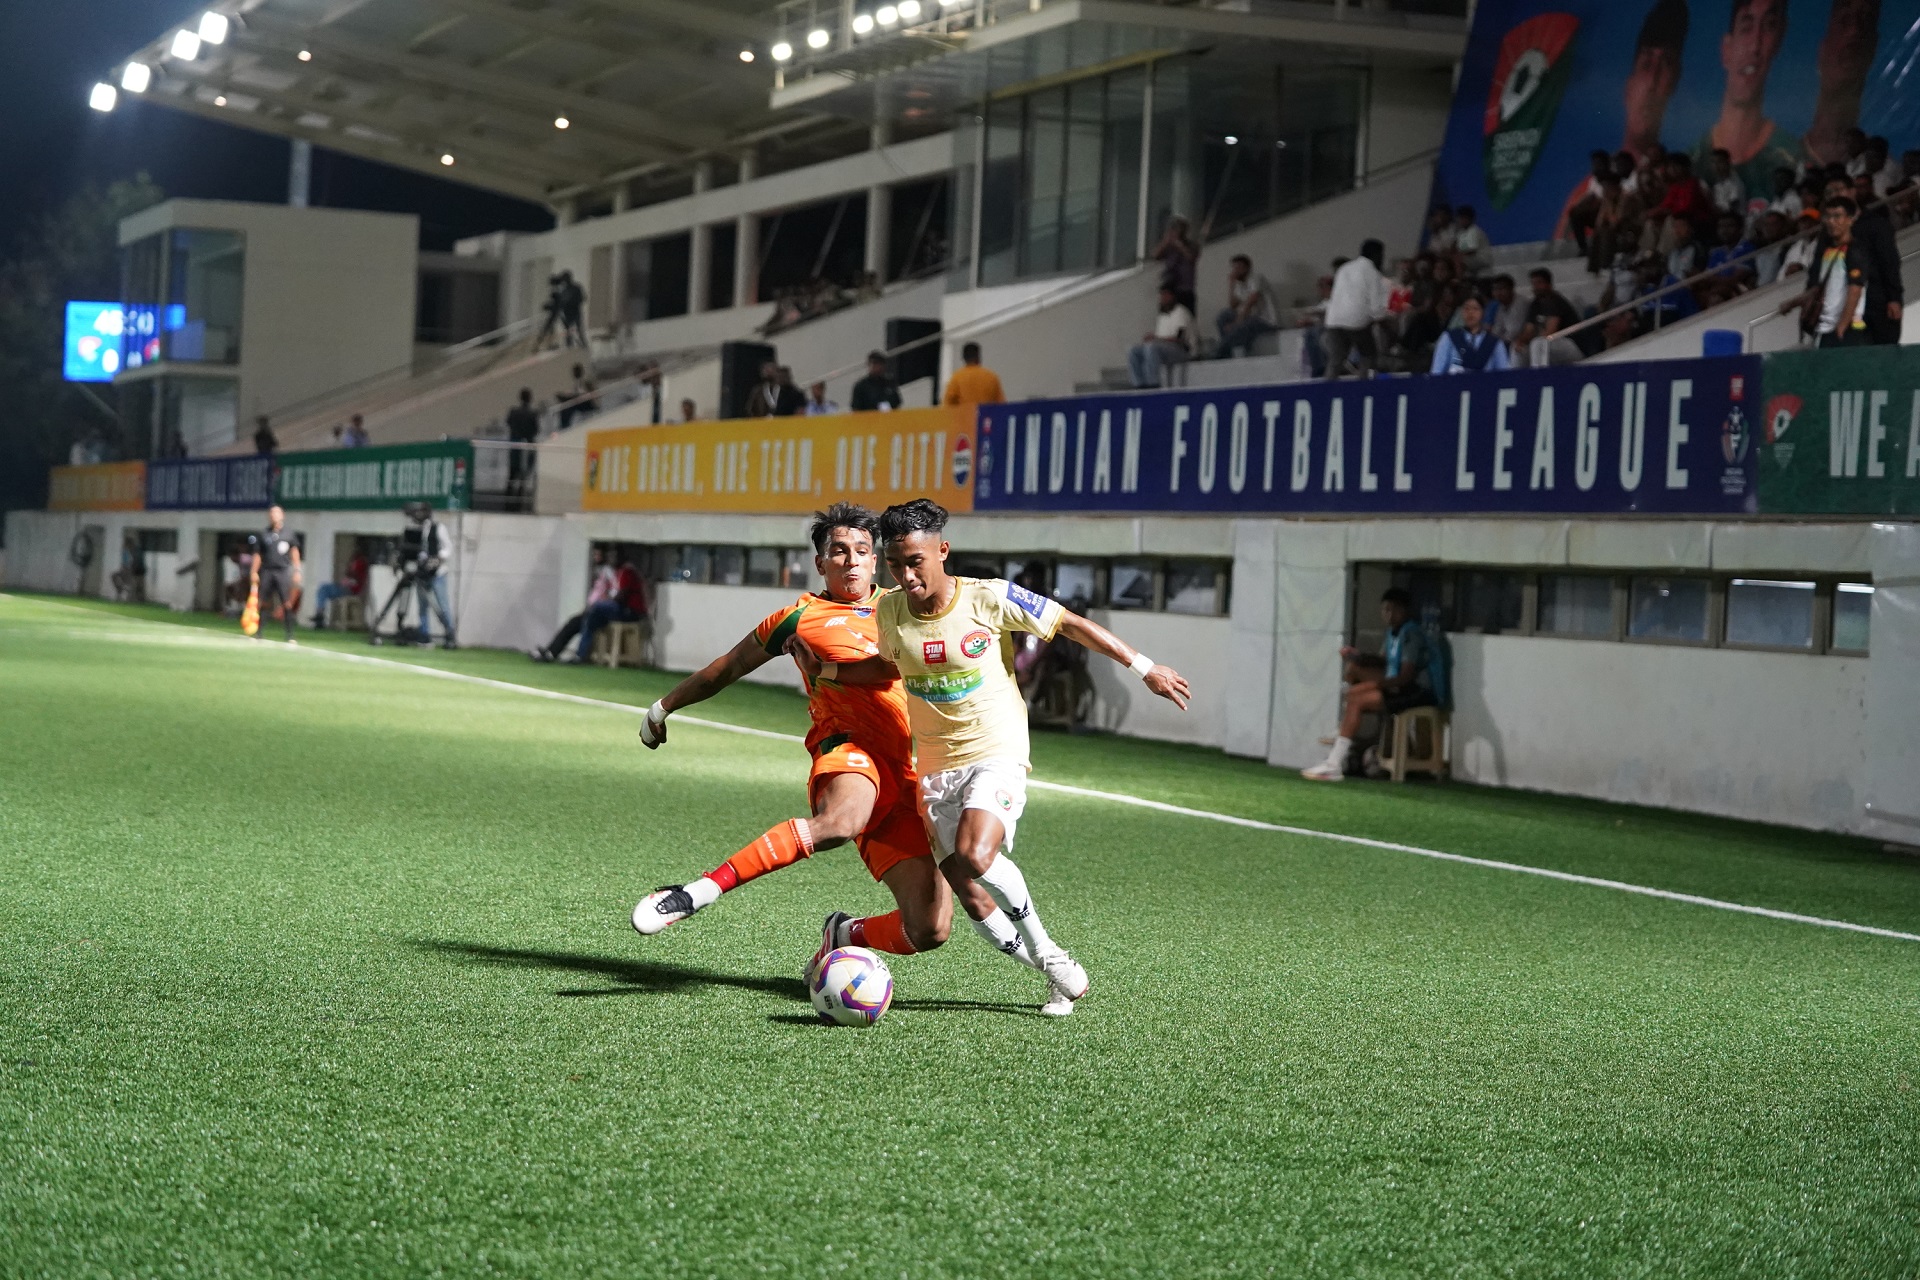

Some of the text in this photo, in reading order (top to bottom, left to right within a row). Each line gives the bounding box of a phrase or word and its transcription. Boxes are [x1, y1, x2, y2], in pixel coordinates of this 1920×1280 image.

[1004, 378, 1694, 495] INDIAN FOOTBALL LEAGUE
[1829, 390, 1889, 478] WE
[600, 444, 632, 493] ONE
[714, 441, 750, 493] ONE
[835, 433, 877, 492] ONE
[889, 430, 948, 492] CITY
[925, 644, 943, 654] STAR
[924, 692, 963, 701] TOURISM
[847, 752, 870, 768] 5
